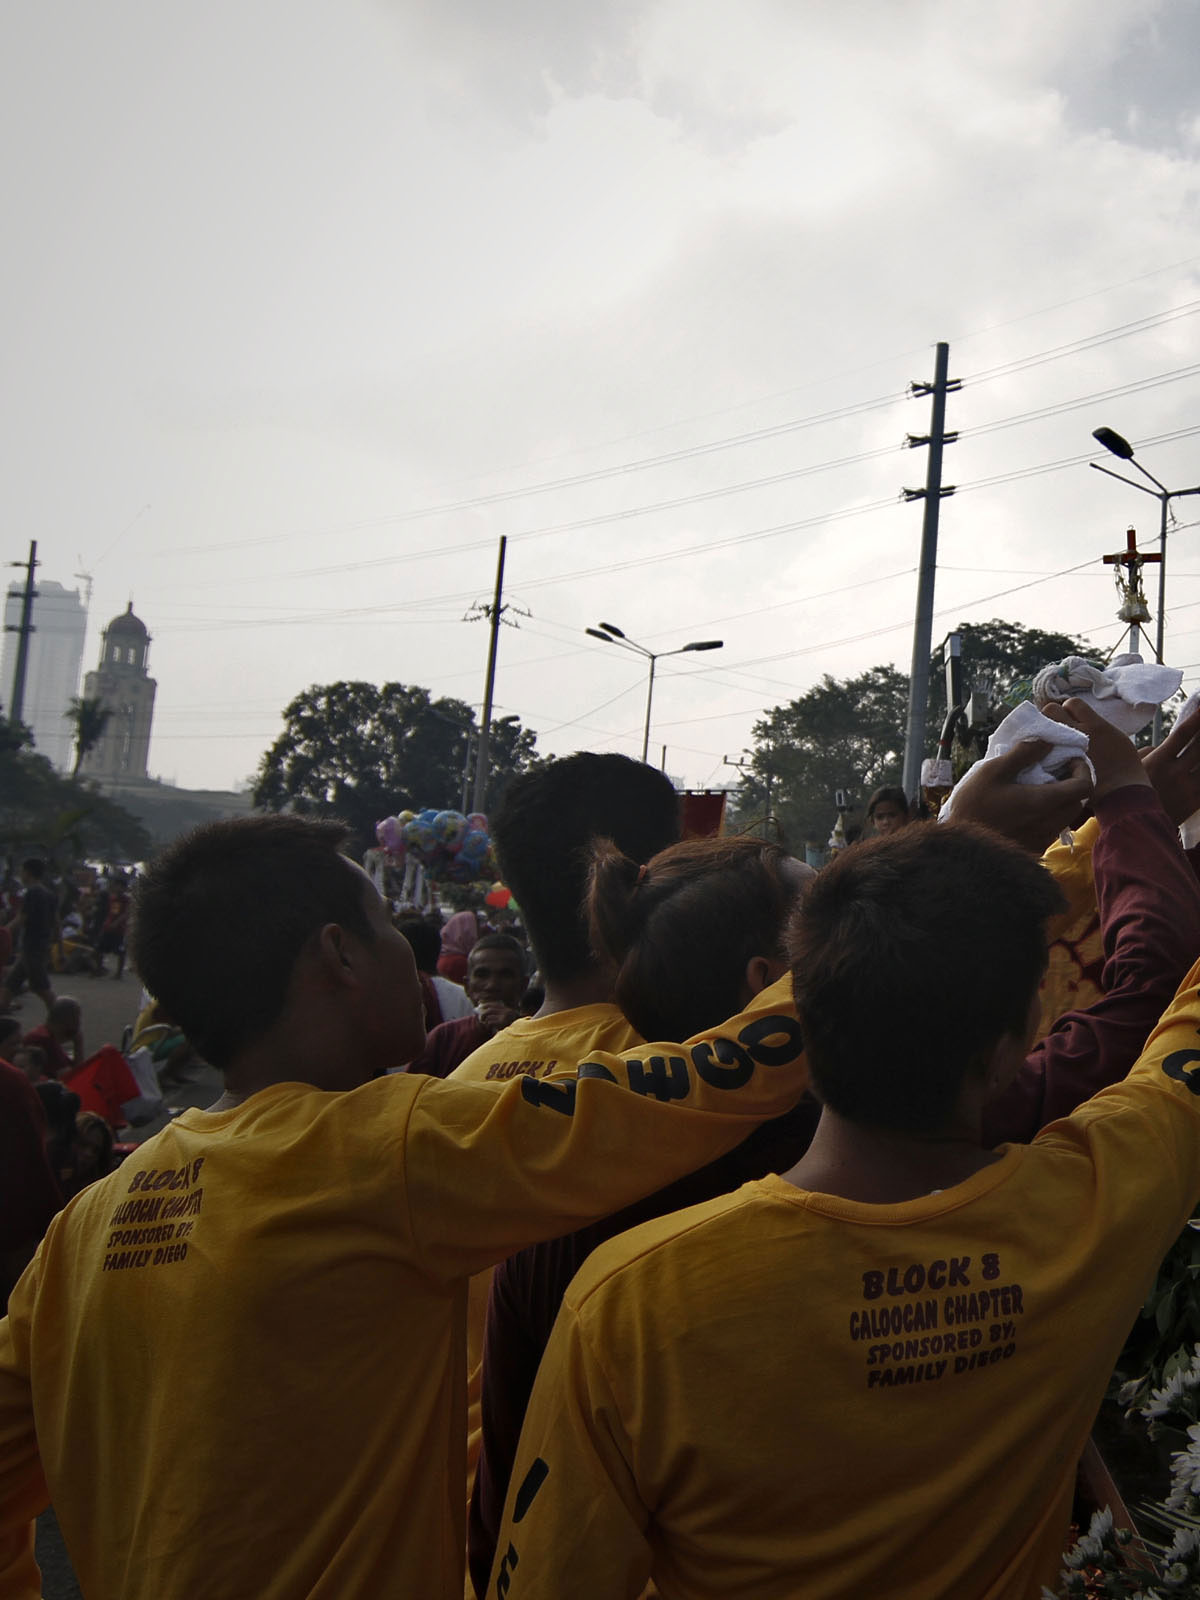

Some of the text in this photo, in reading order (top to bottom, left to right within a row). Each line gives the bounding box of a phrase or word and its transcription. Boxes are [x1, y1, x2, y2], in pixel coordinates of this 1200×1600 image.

[485, 1061, 545, 1080] BLOCK
[127, 1161, 191, 1193] BLOCK
[107, 1223, 175, 1248] SPONSORED
[103, 1243, 188, 1271] FAMILY DIEGO
[862, 1253, 1001, 1300] BLOCK 8
[850, 1285, 1024, 1341] CALOOCAN CHAPTER
[866, 1328, 983, 1365] SPONSORED
[867, 1343, 1016, 1388] FAMILY DIEGO
